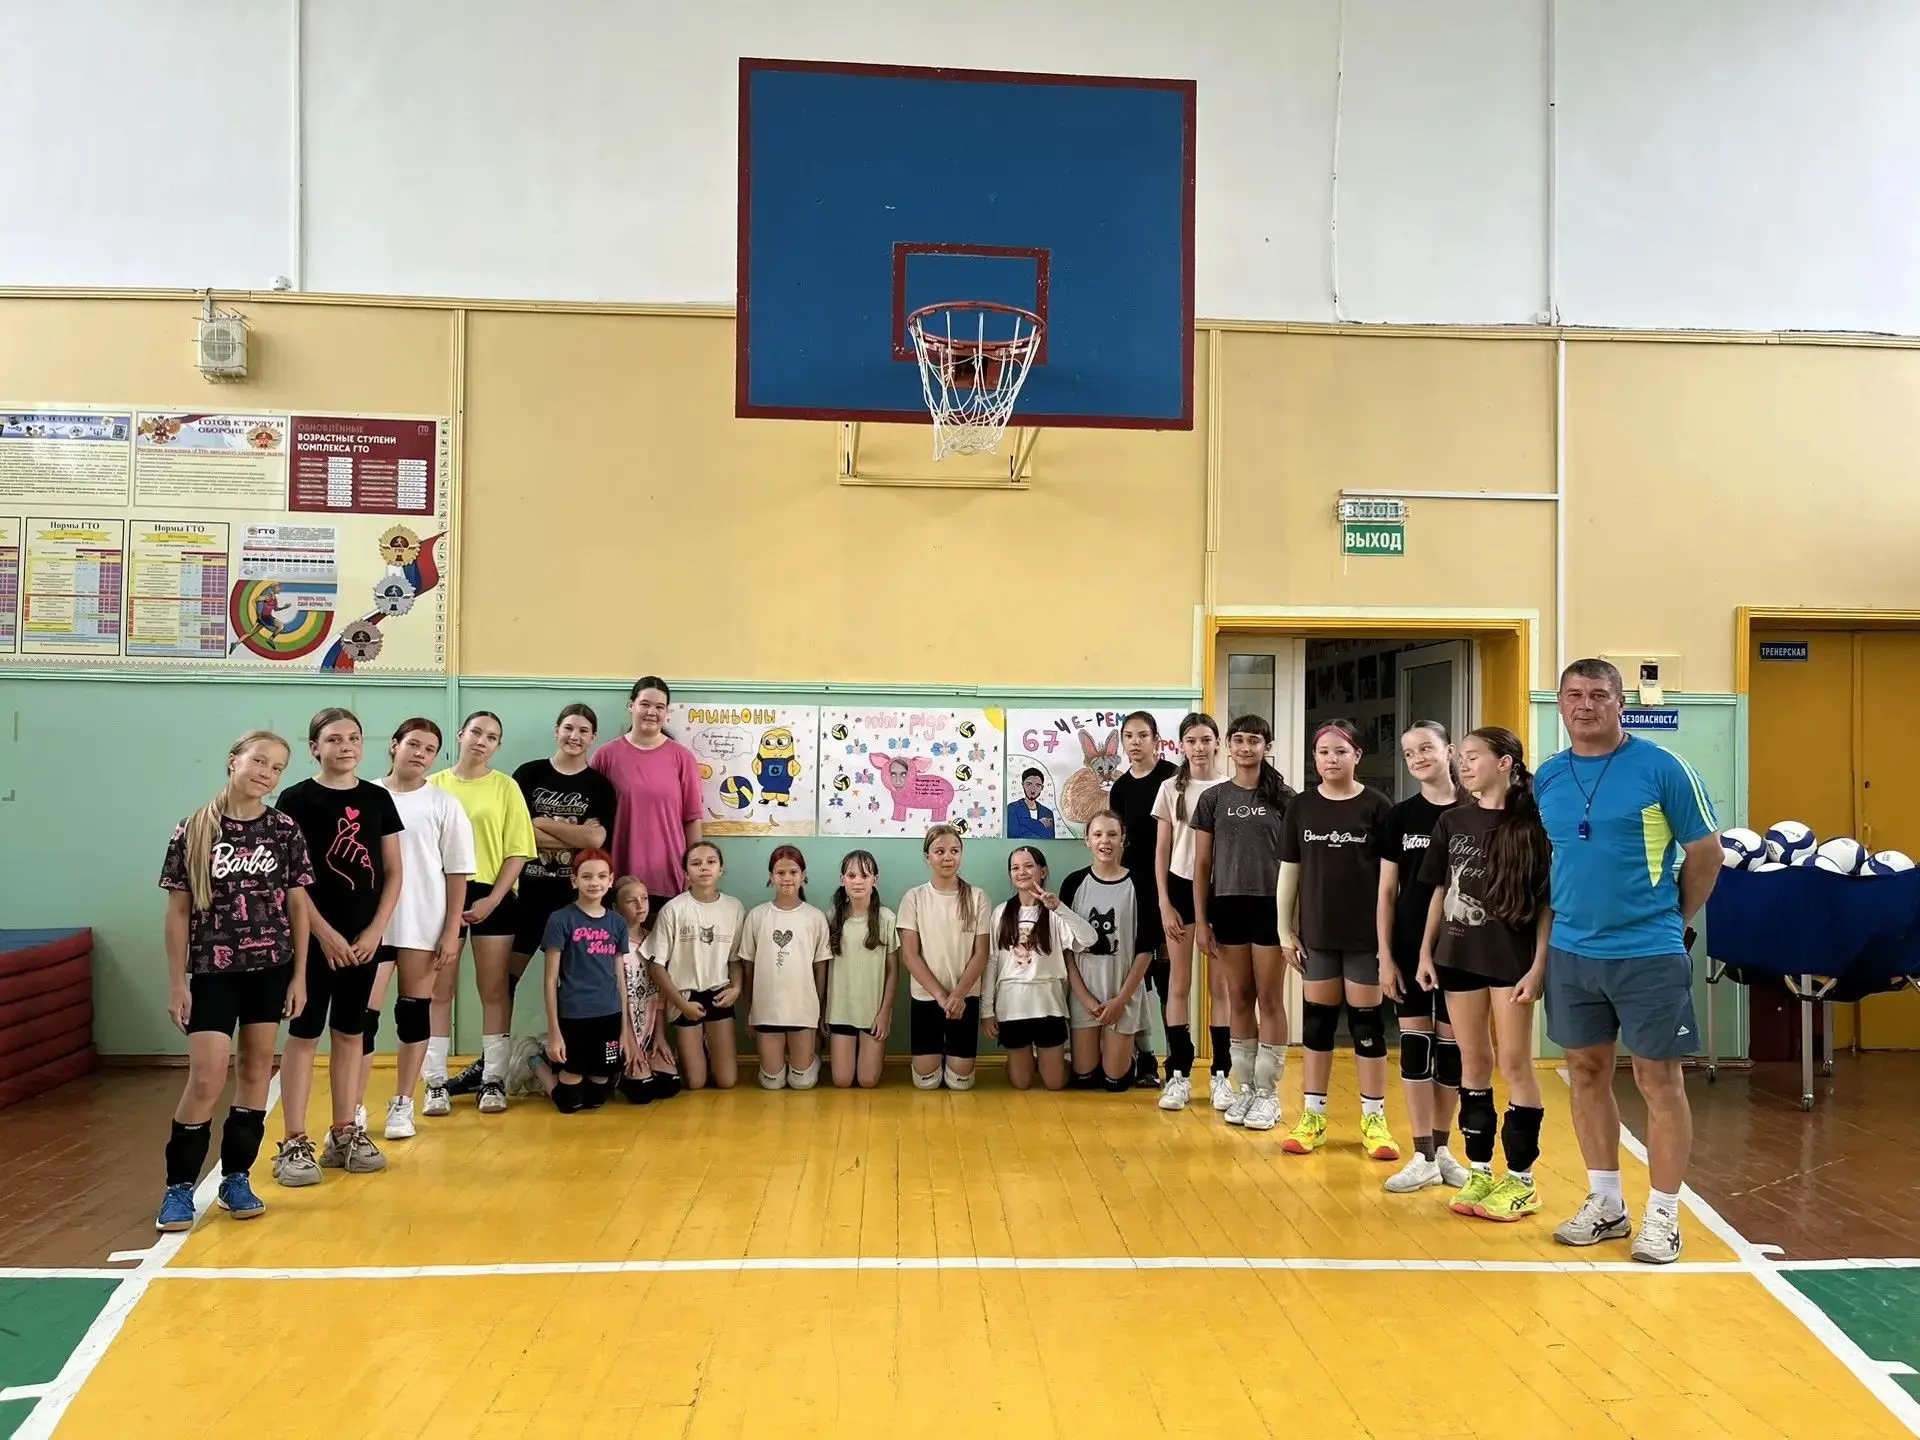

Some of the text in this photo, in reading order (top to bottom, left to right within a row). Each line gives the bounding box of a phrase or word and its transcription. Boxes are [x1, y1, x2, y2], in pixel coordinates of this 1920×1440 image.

[198, 419, 232, 427] ГОТОВ
[241, 420, 275, 429] ТРУДУ
[198, 427, 245, 435] ОБОРОНЕ
[297, 433, 396, 445] ВОЗРАСТНЫЕ СТУПЕНИ
[297, 443, 370, 453] КОМПЛЕКСА ГТО
[50, 521, 100, 531] Нормы ГТО
[154, 524, 205, 533] Нормы ГТО
[1345, 532, 1402, 551] ВЫХОД
[1761, 647, 1806, 656] ТРЕНЕРСКАЯ
[688, 708, 776, 725] МИНЬОНЫ
[1022, 729, 1059, 753] 67
[1227, 805, 1267, 818] LOVE
[212, 842, 278, 879] Barbie
[573, 927, 610, 941] Pink
